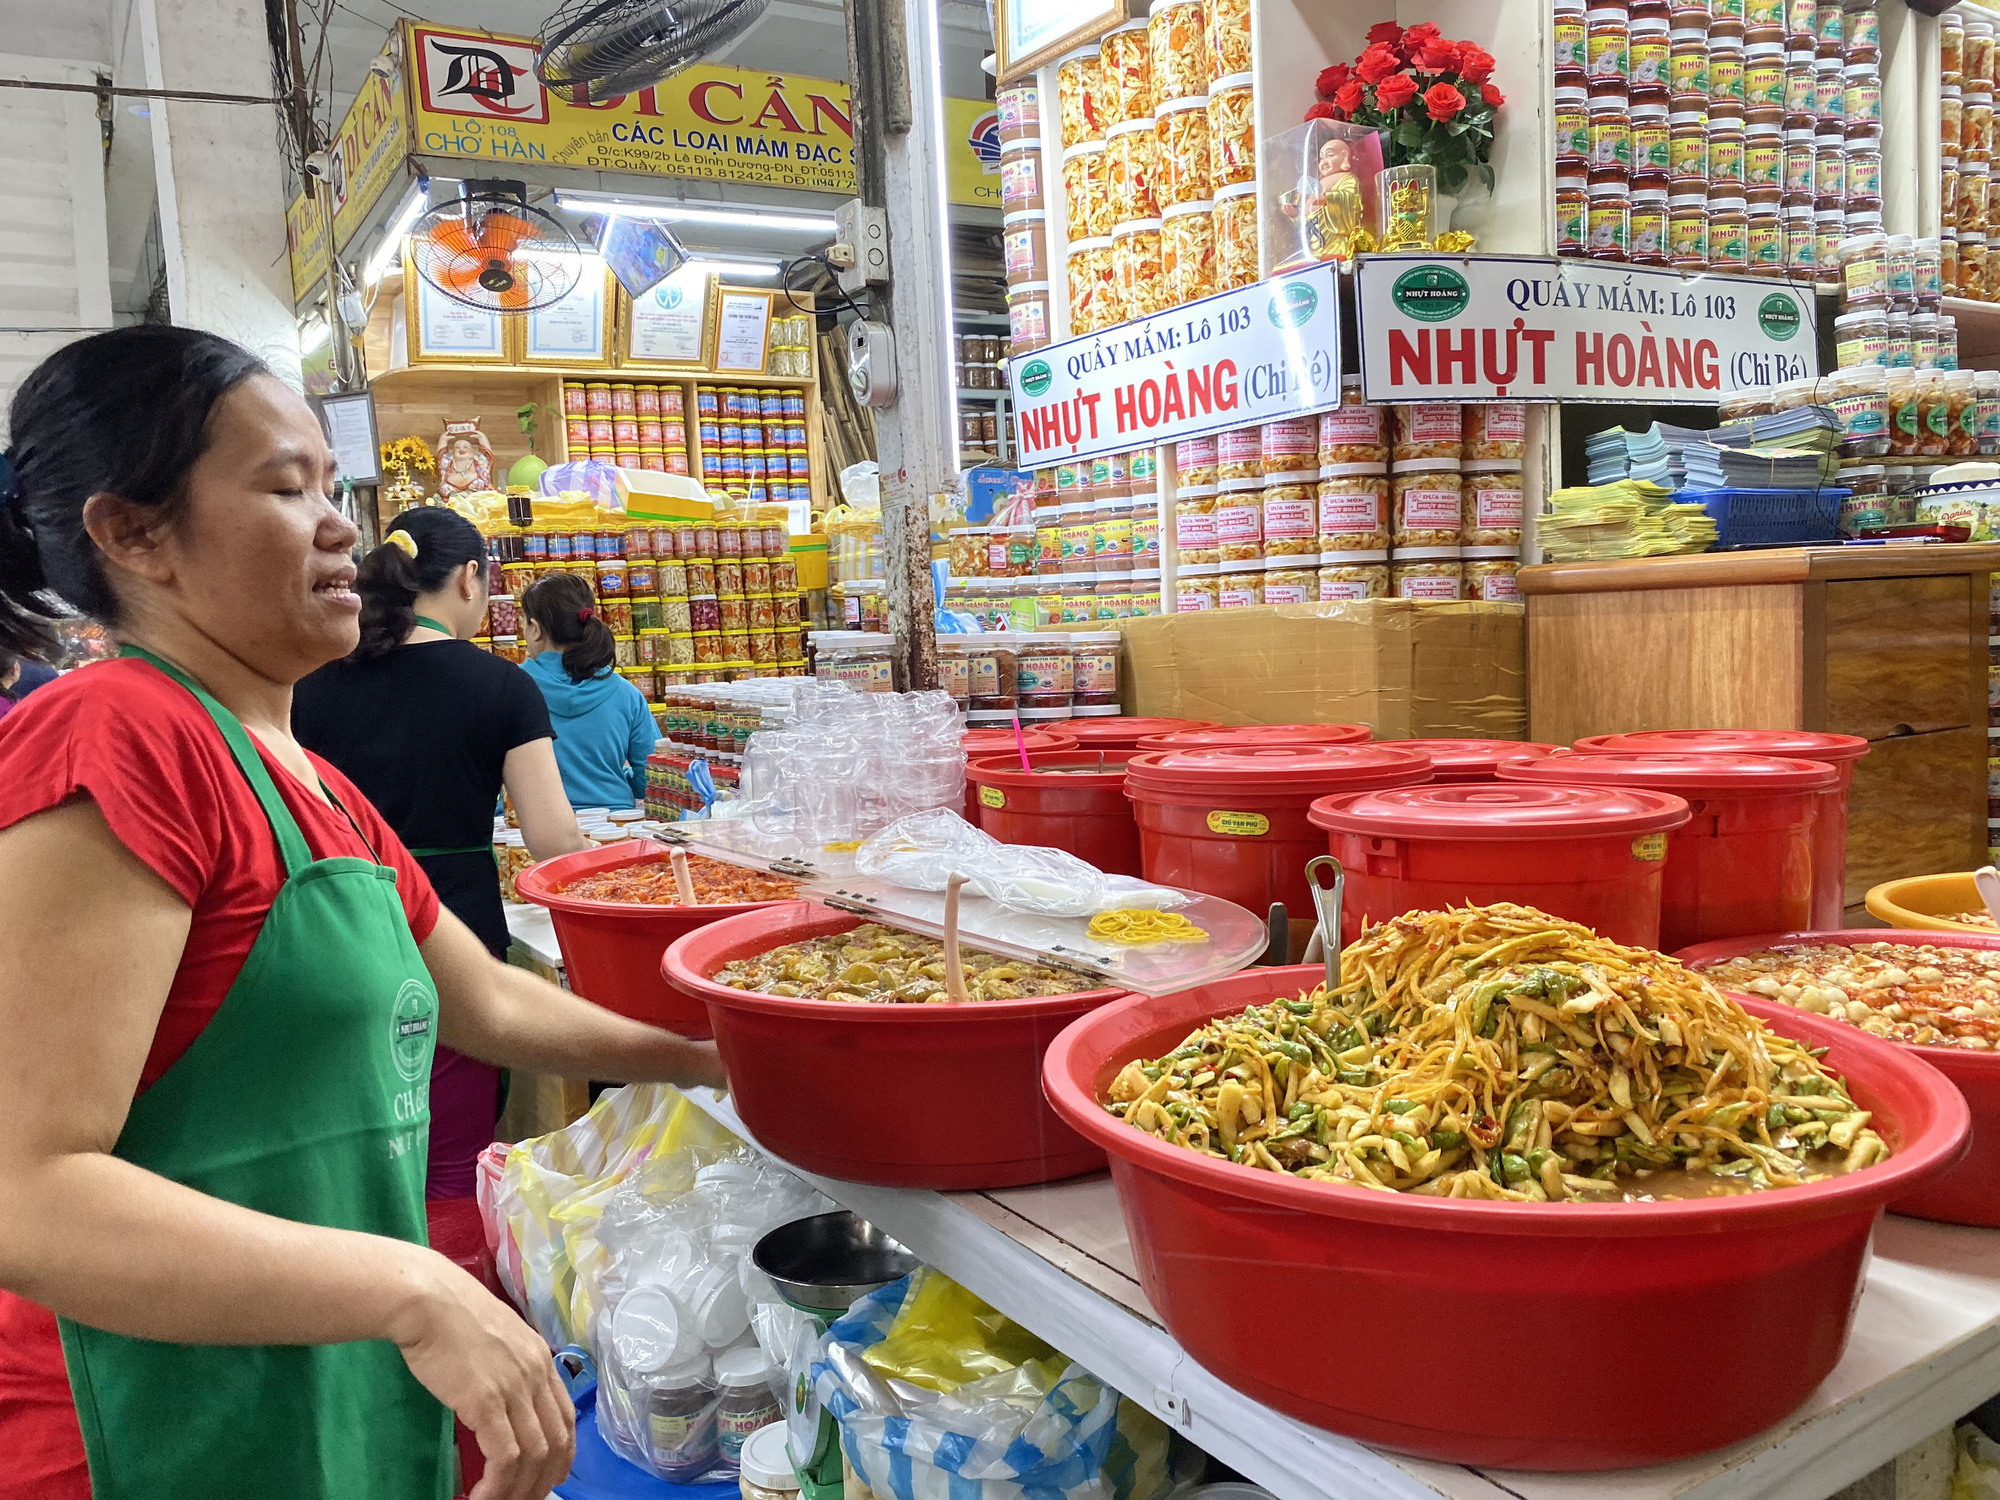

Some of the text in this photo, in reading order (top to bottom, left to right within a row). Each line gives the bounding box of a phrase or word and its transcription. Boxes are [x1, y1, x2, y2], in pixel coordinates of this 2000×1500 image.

[492, 137, 546, 160] HÀN
[552, 136, 588, 164] Chuyên
[587, 130, 610, 144] bán
[612, 120, 665, 145] CÁC
[673, 129, 728, 156] LOẠI
[674, 153, 690, 163] Lê
[694, 154, 723, 167] Đình
[1430, 289, 1458, 297] HOÀNG
[1597, 274, 1665, 316] MẮM:
[1671, 291, 1697, 318] Lô
[1704, 294, 1736, 320] 103
[1067, 305, 1251, 380] QUẦY MẮM: Lô 103
[1388, 317, 1555, 396] NHỰT
[1575, 320, 1721, 391] HOÀNG
[1020, 387, 1101, 454] NHỰT
[1114, 358, 1239, 434] HOÀNG
[1244, 359, 1288, 408] (Chị
[1941, 507, 1975, 521] Danisa
[394, 1089, 417, 1122] CH
